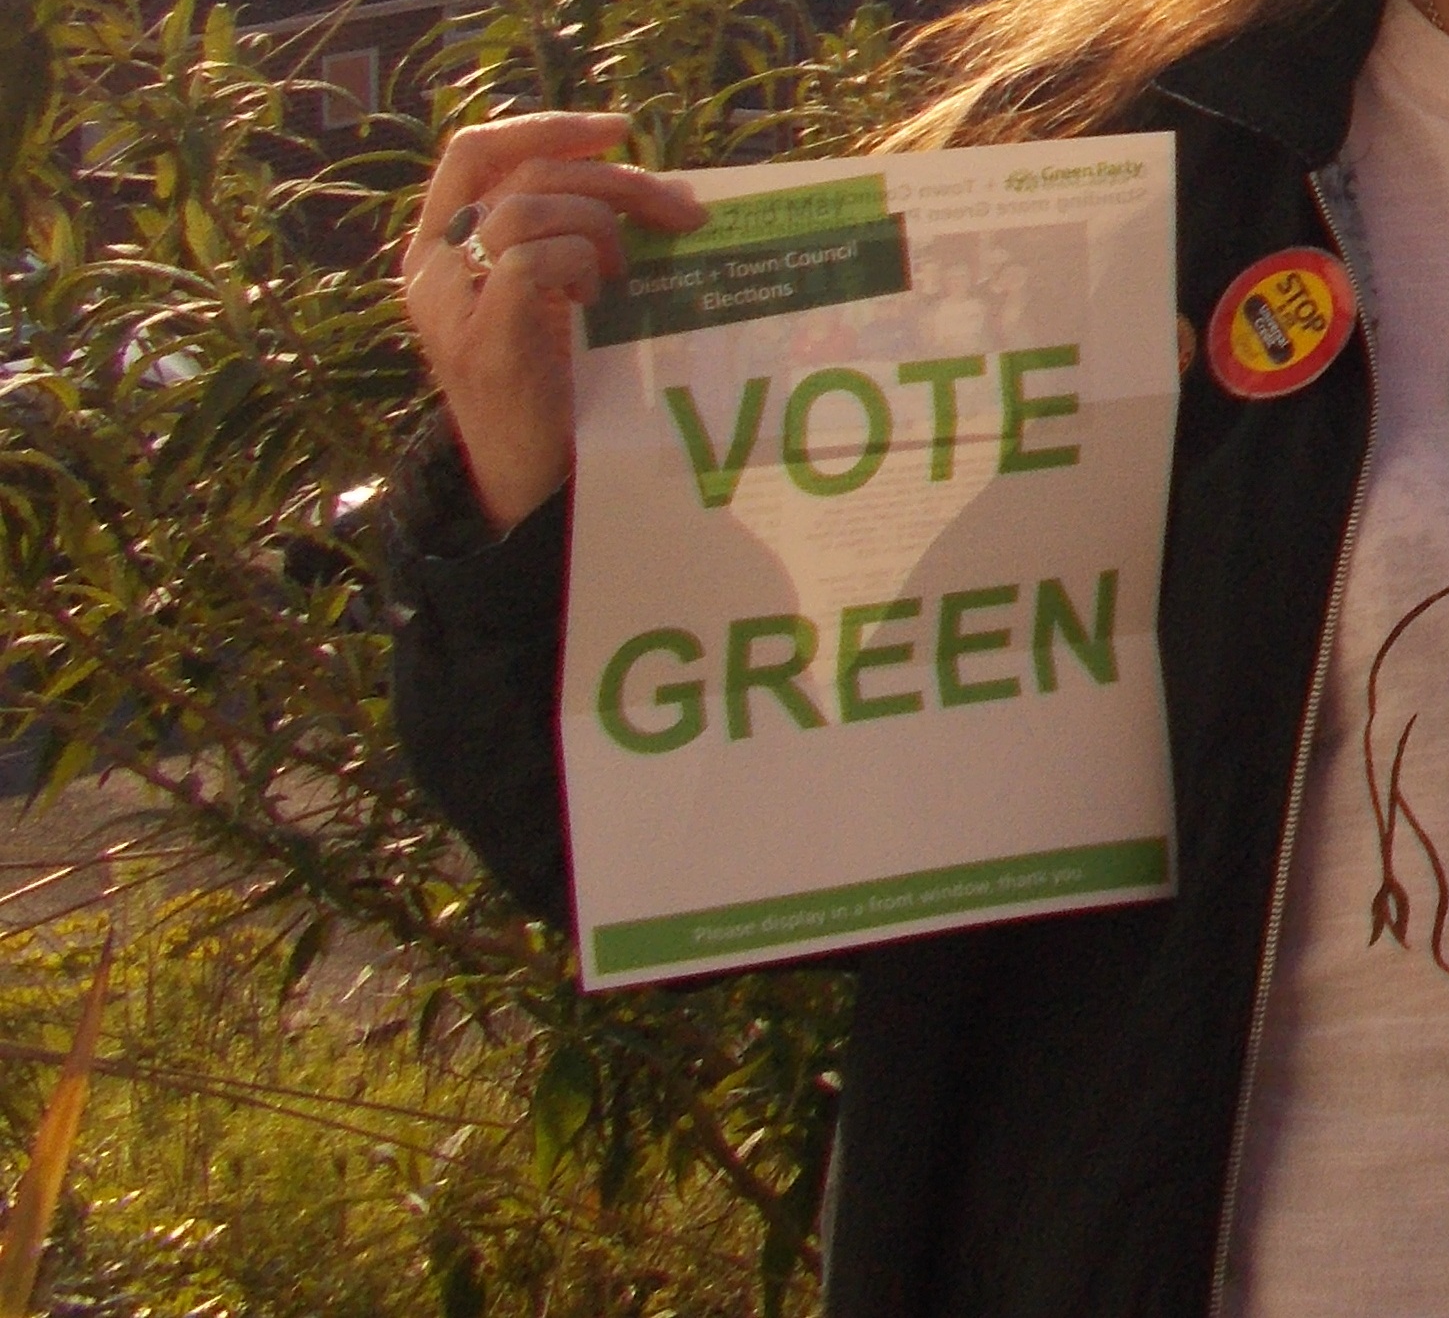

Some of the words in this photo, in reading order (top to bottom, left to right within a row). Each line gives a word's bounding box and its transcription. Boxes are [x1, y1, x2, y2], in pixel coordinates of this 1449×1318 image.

[1041, 164, 1093, 182] Green
[1097, 160, 1144, 180] Party
[724, 196, 780, 229] 2nd
[786, 189, 845, 221] May
[629, 268, 703, 298] District
[709, 269, 720, 281] +
[725, 258, 780, 280] Town
[784, 238, 859, 270] Council
[701, 282, 795, 312] Elections
[1275, 271, 1327, 332] STOP
[664, 343, 1081, 510] VOTE
[598, 568, 1121, 757] GREEN
[761, 911, 827, 934] display
[868, 893, 914, 915] front
